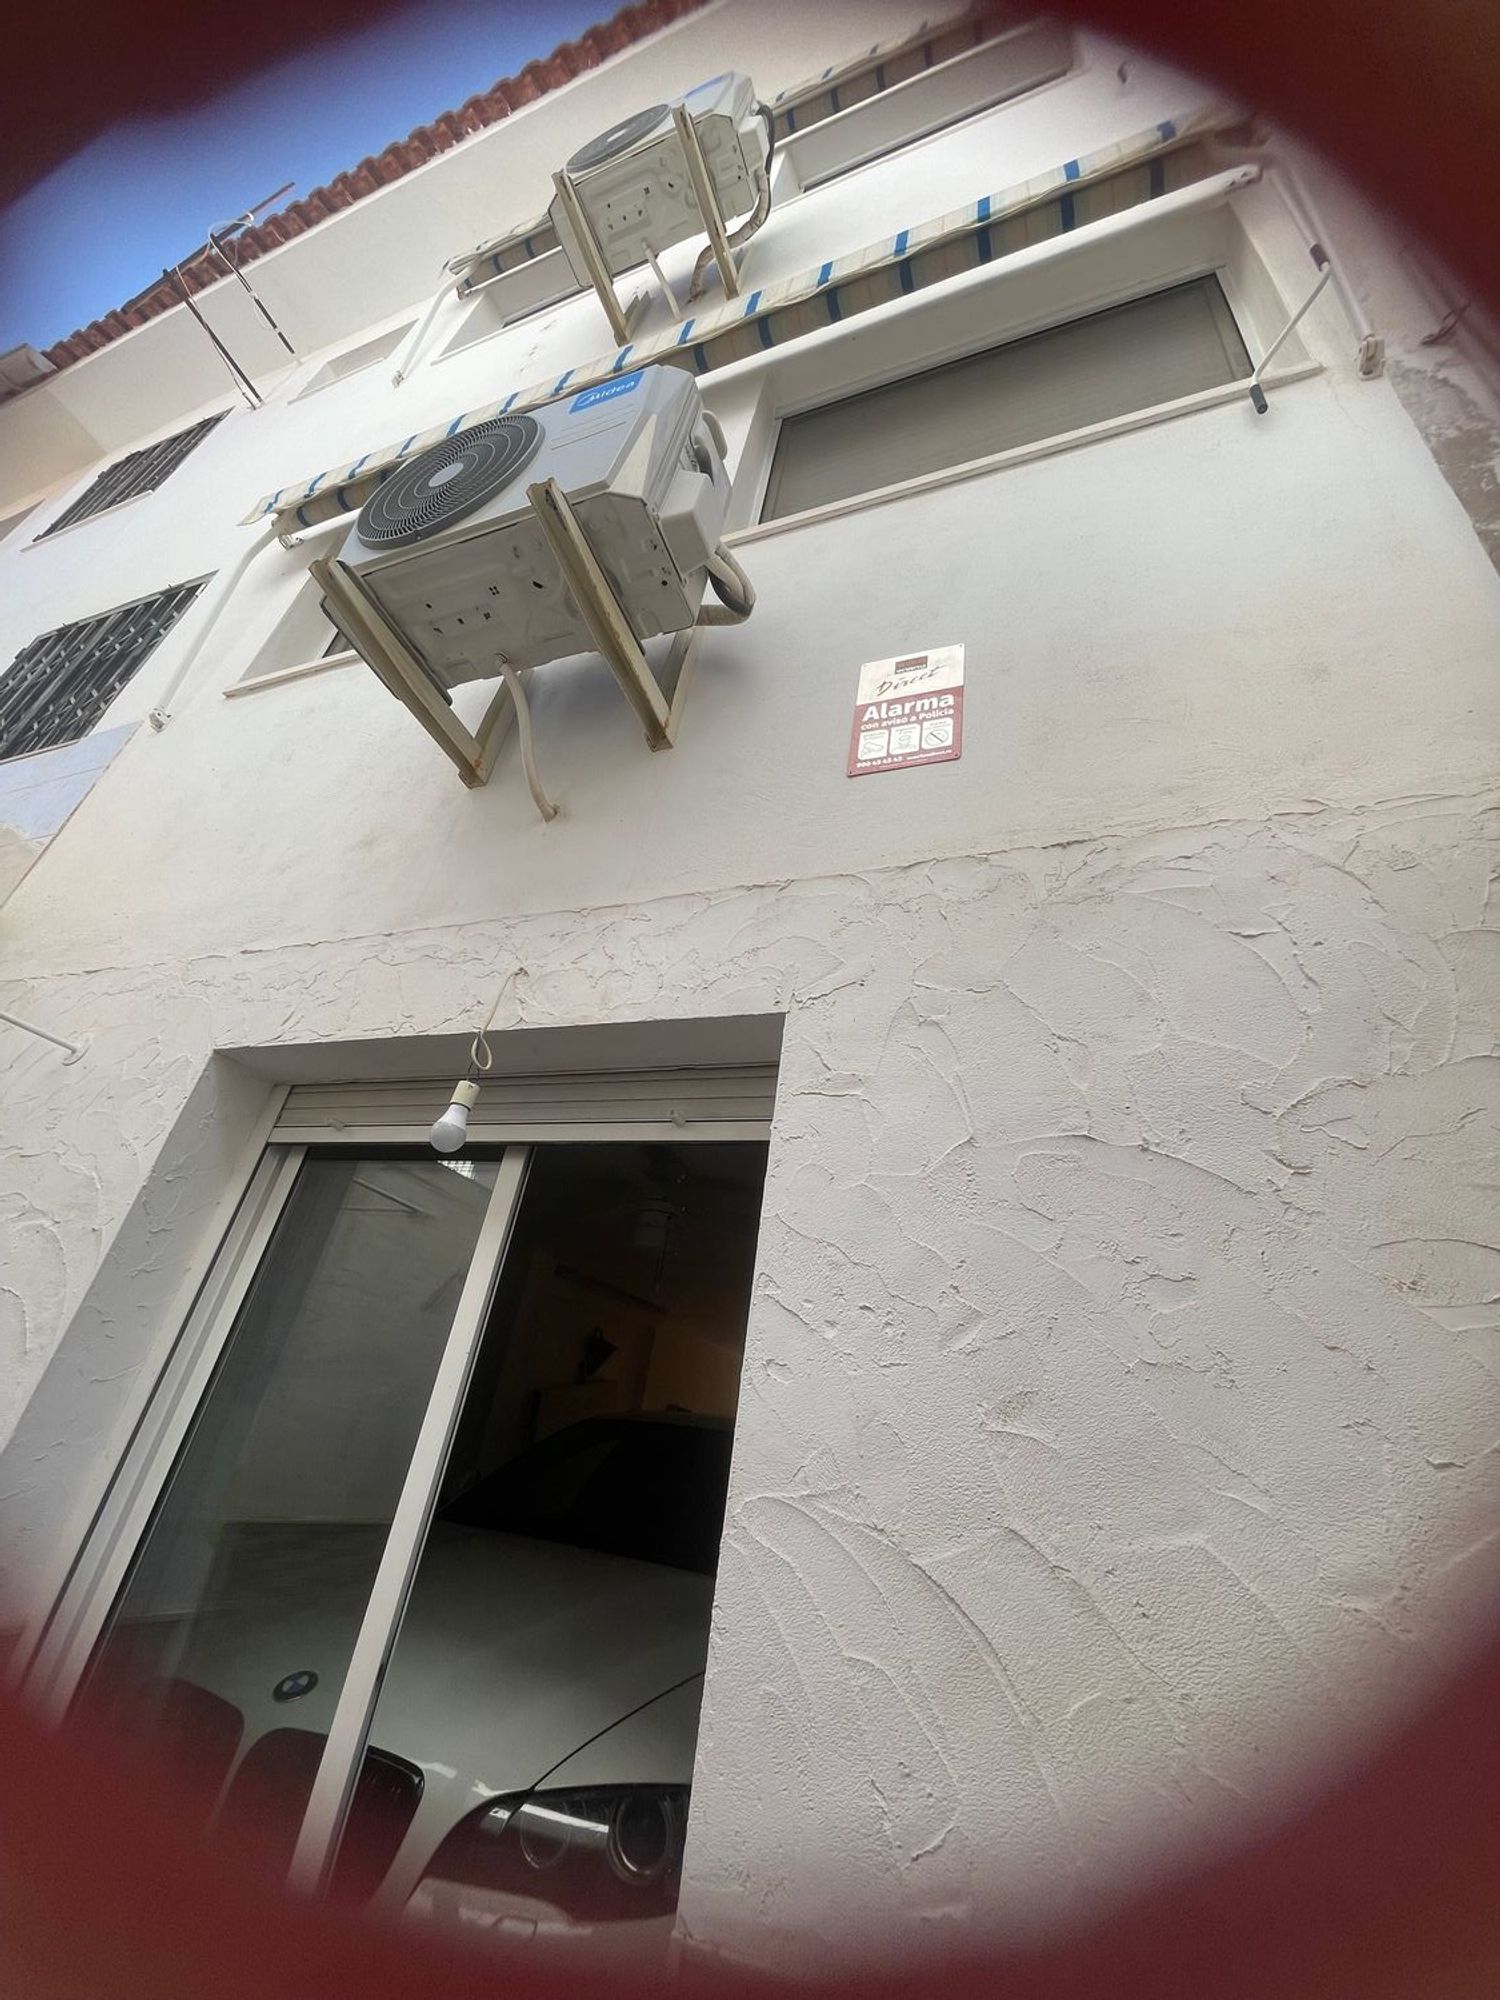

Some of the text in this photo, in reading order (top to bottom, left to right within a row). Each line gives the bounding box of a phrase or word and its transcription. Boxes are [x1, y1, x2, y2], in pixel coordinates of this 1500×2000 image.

[577, 381, 635, 406] Midea
[861, 694, 955, 722] Alarma
[860, 722, 880, 732] con
[881, 717, 909, 728] aviso
[909, 715, 918, 723] a
